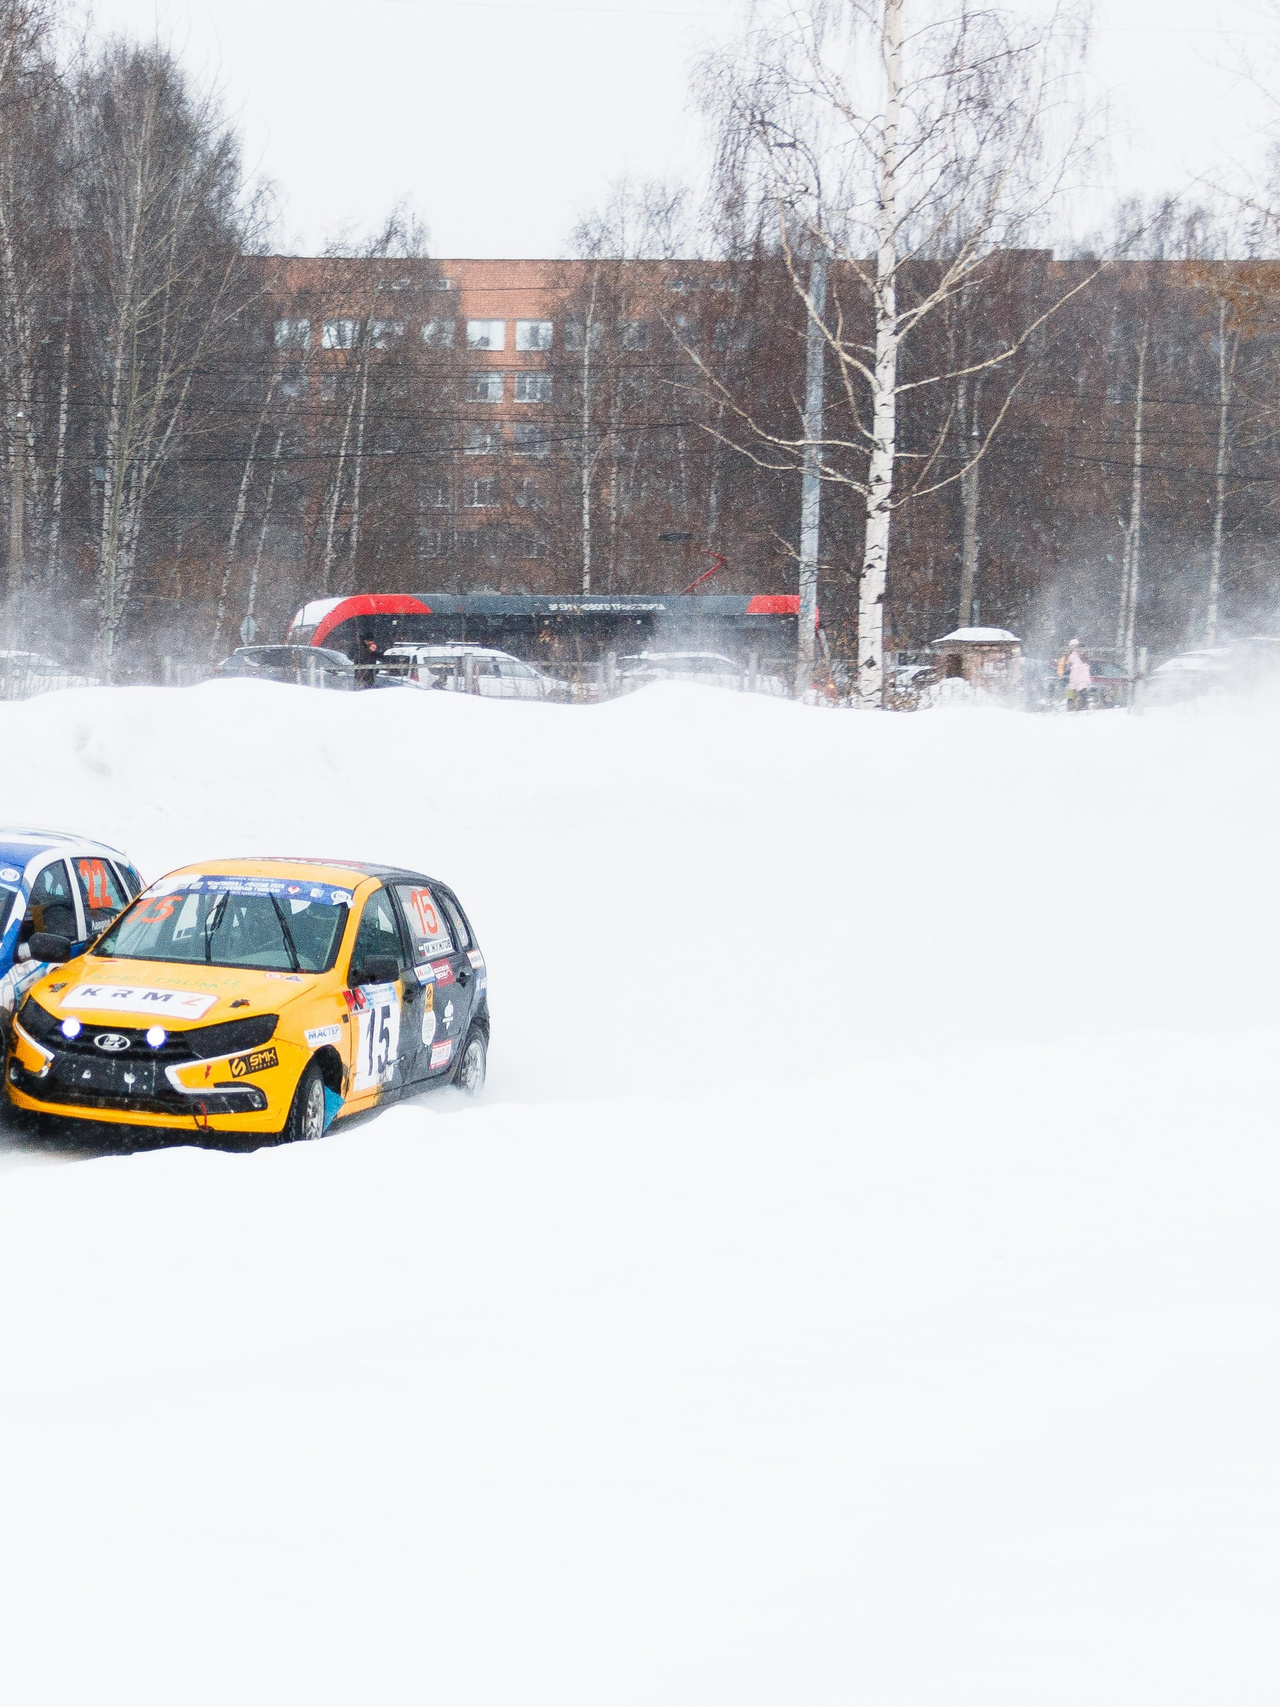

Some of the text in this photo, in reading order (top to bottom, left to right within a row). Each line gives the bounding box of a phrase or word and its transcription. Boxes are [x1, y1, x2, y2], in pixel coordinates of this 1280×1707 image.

[77, 858, 114, 910] 22
[125, 895, 183, 924] 15
[410, 888, 438, 936] 15
[79, 986, 205, 1007] KRMZ
[308, 1025, 340, 1040] МАСТЕР
[365, 1004, 391, 1076] 15
[249, 1049, 277, 1067] SMK
